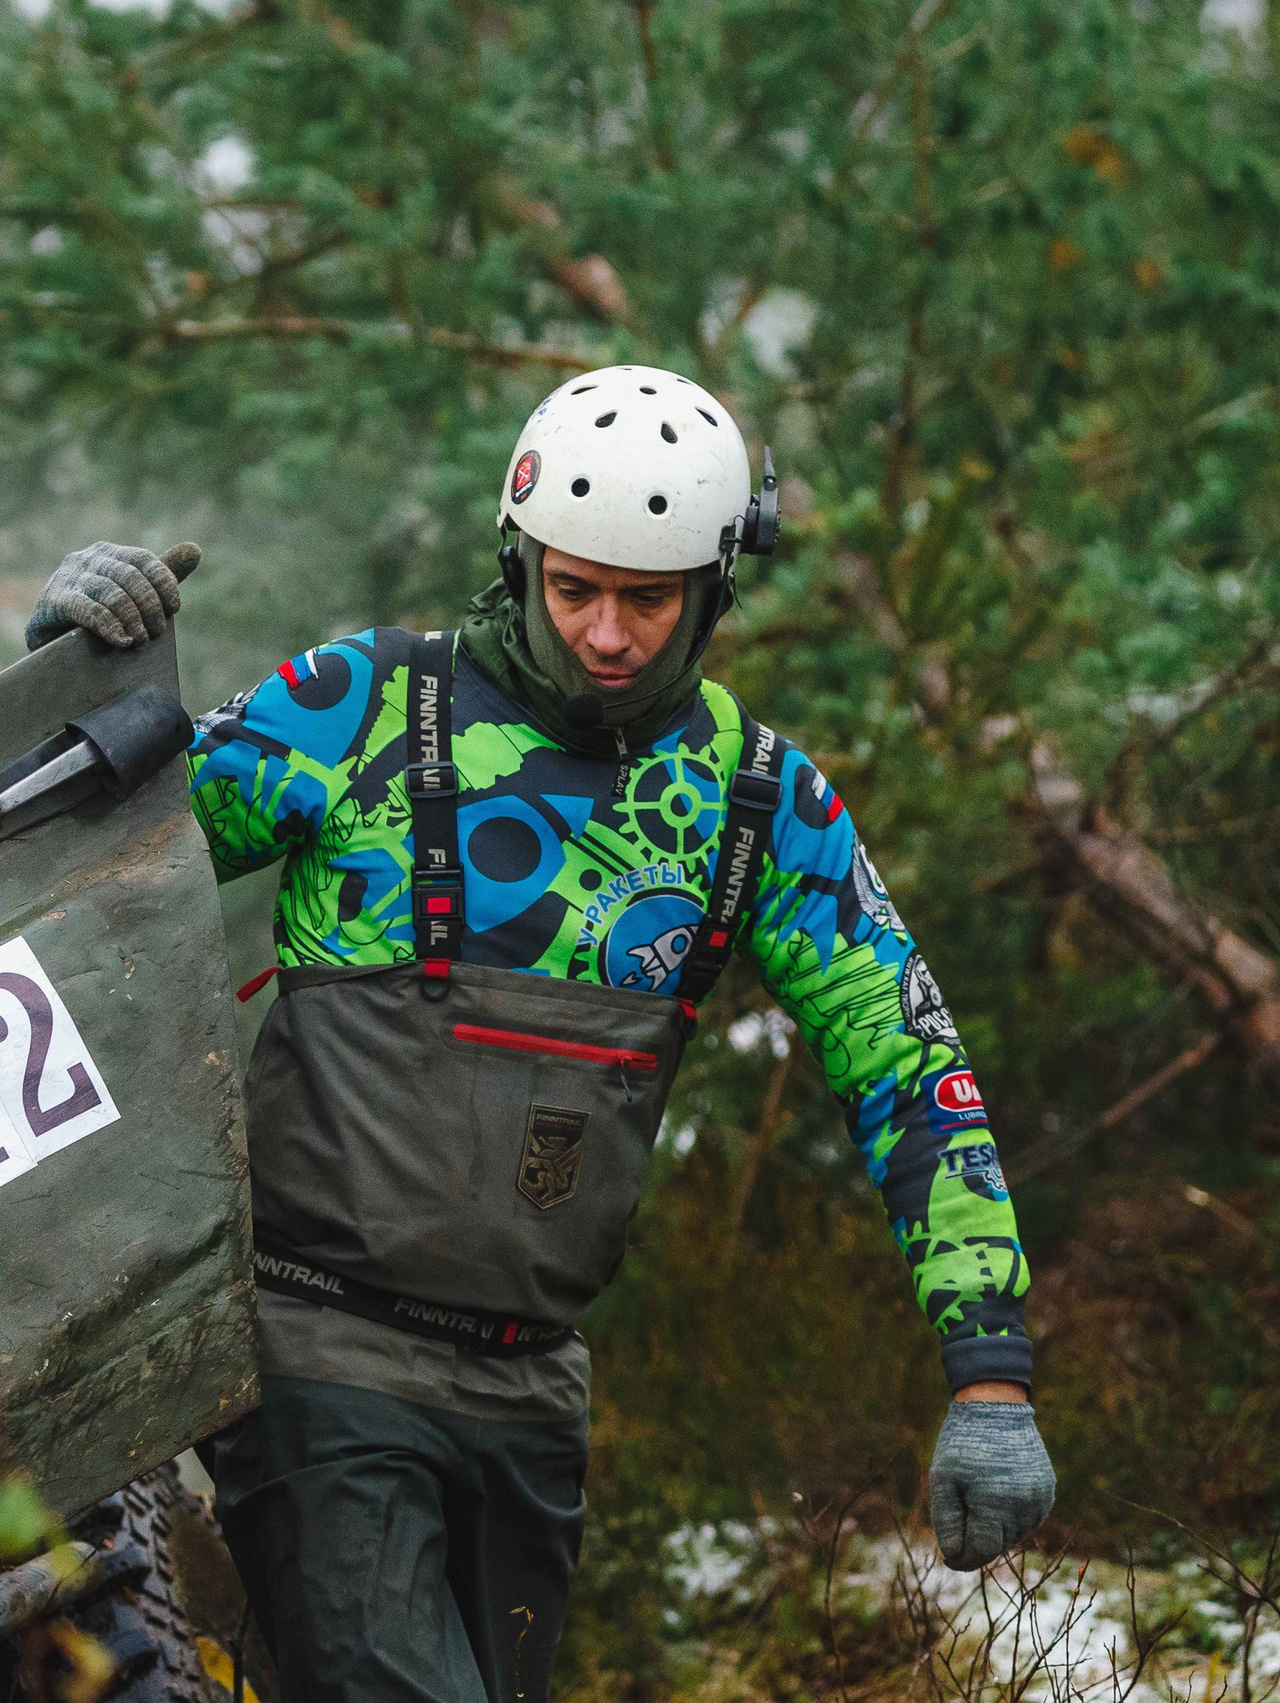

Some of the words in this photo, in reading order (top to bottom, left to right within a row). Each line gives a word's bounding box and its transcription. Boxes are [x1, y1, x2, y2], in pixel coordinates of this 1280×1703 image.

[615, 764, 629, 796] SPLAV
[583, 862, 684, 926] РАКЕТЫ
[577, 927, 599, 947] У
